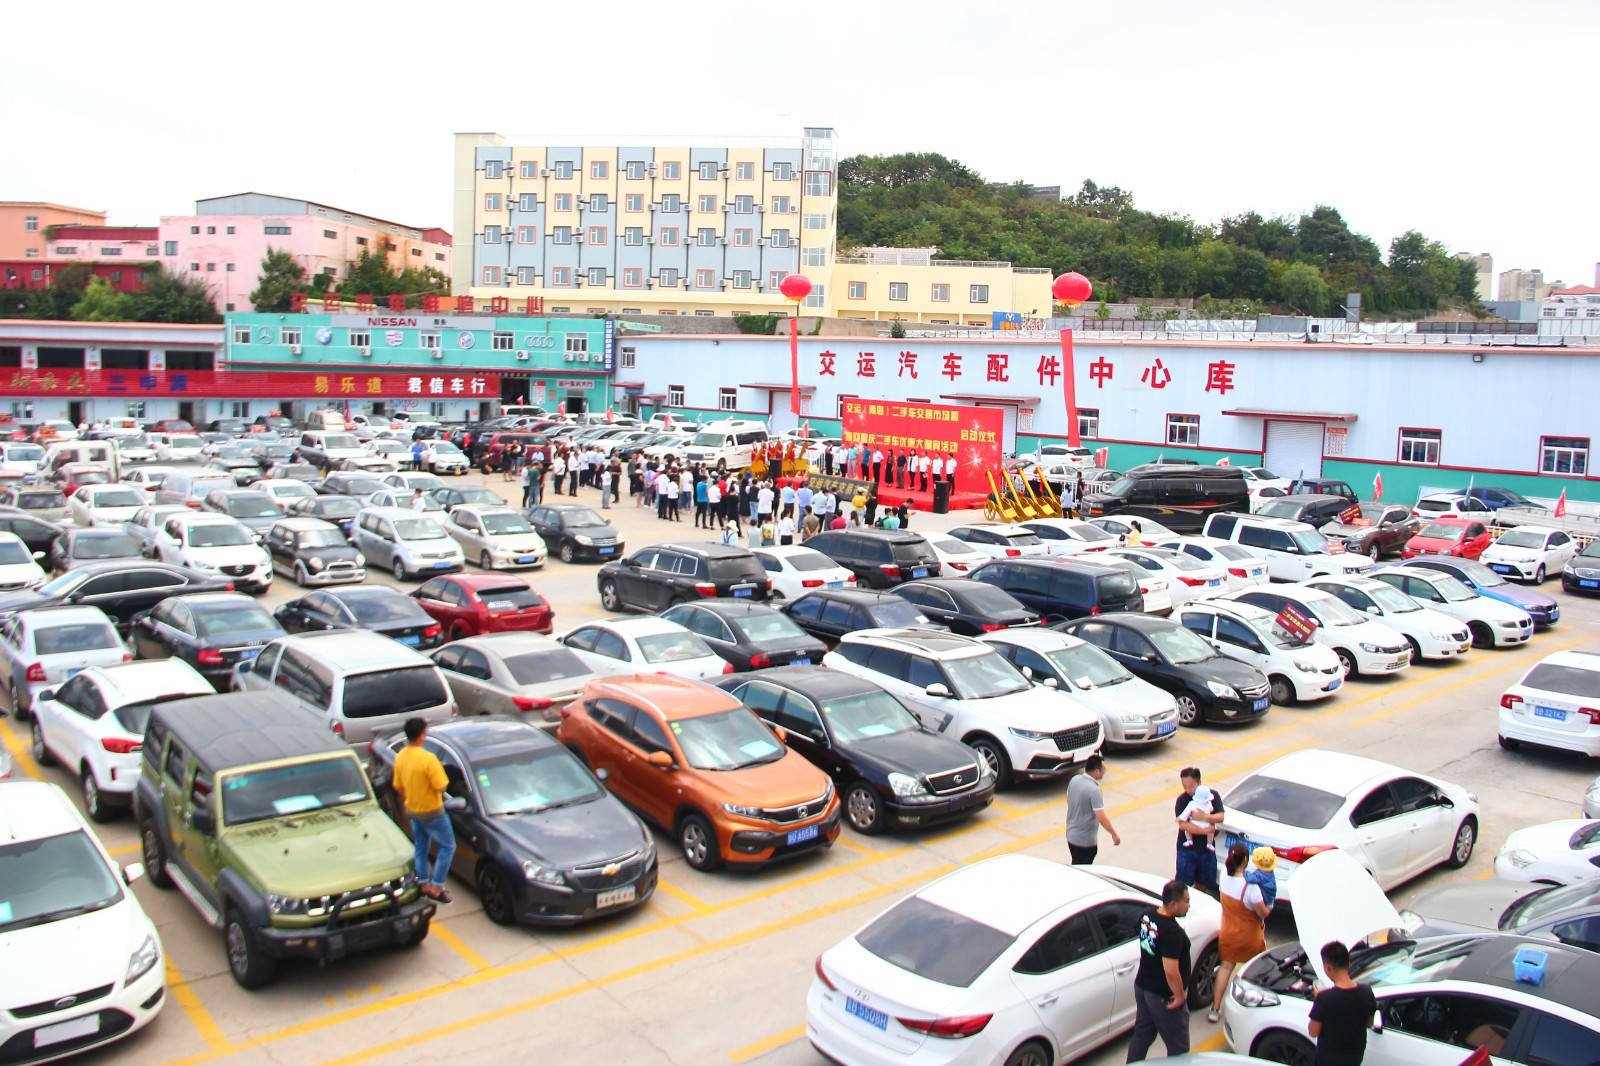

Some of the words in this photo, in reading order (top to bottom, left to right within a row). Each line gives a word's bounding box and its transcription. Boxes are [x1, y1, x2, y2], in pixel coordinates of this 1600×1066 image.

[368, 317, 417, 327] NISSAN
[819, 350, 1236, 395] 交运汽车配件中心库
[314, 376, 382, 393] 易乐道
[407, 377, 485, 394] 君信车行
[960, 429, 996, 443] 启动仪式
